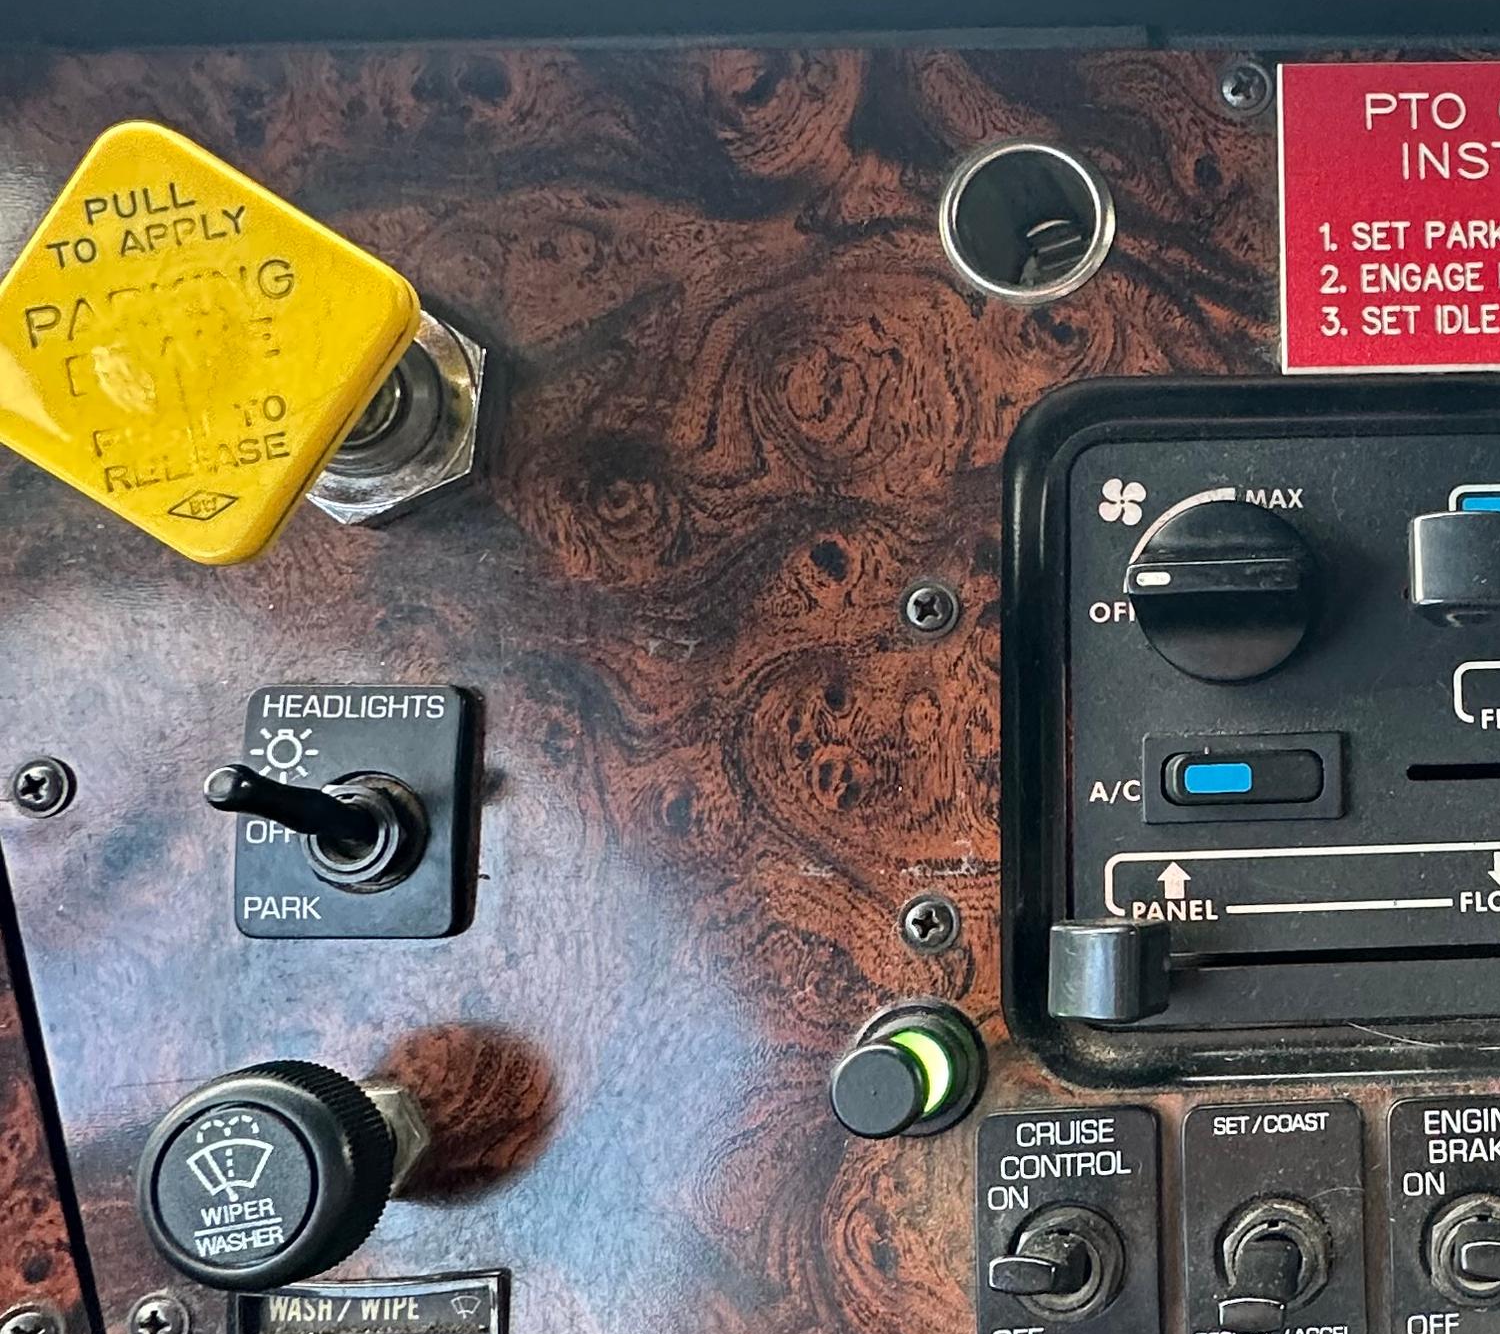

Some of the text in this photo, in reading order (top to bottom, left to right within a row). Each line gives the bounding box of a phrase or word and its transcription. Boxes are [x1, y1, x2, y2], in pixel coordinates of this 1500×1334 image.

[1366, 93, 1465, 129] PTO
[85, 183, 195, 224] PULL
[46, 206, 246, 269] TO APPLY
[1319, 223, 1337, 251] 1.
[1352, 221, 1410, 250] SET
[1320, 265, 1346, 293] 2.
[1361, 262, 1483, 293] ENGAGE
[1321, 304, 1500, 336] 3. SET IDLE
[1246, 488, 1303, 508] MAX
[263, 695, 444, 718] HEADLIGHTS
[1090, 780, 1140, 803] A/C
[244, 897, 321, 919] PARK
[1132, 899, 1218, 921] PANEL
[1017, 1119, 1114, 1147] CRUISE
[1001, 1151, 1131, 1180] CONTROL
[988, 1186, 1028, 1210] ON
[1404, 1172, 1444, 1196] ON
[201, 1198, 275, 1227] WIPER
[195, 1226, 284, 1257] WASHER
